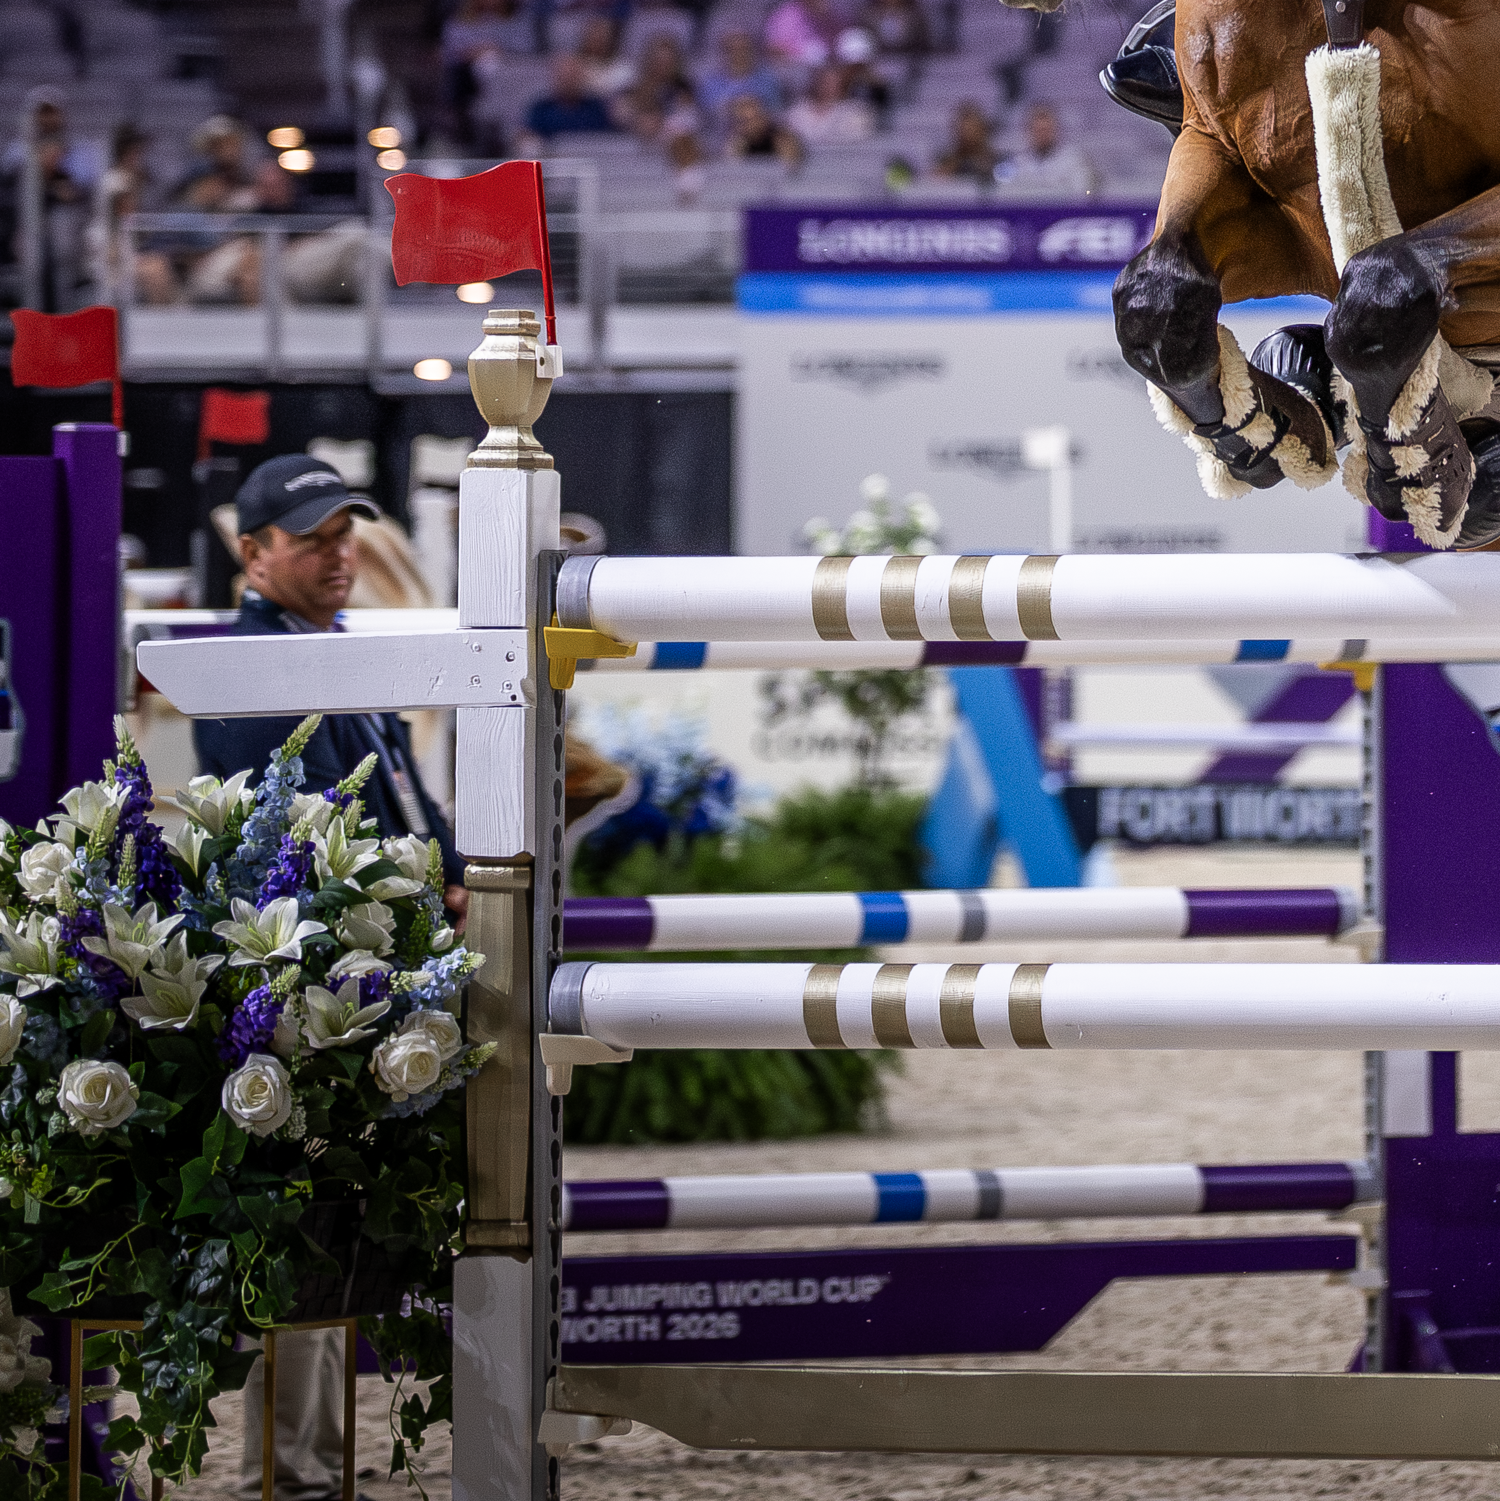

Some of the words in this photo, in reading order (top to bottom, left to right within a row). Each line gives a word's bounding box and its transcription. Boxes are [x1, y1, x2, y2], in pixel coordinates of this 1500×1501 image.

[1099, 787, 1218, 842] FORT
[582, 1281, 715, 1313] JUMPING
[715, 1276, 821, 1307] WORLD
[665, 1311, 742, 1342] 2026
